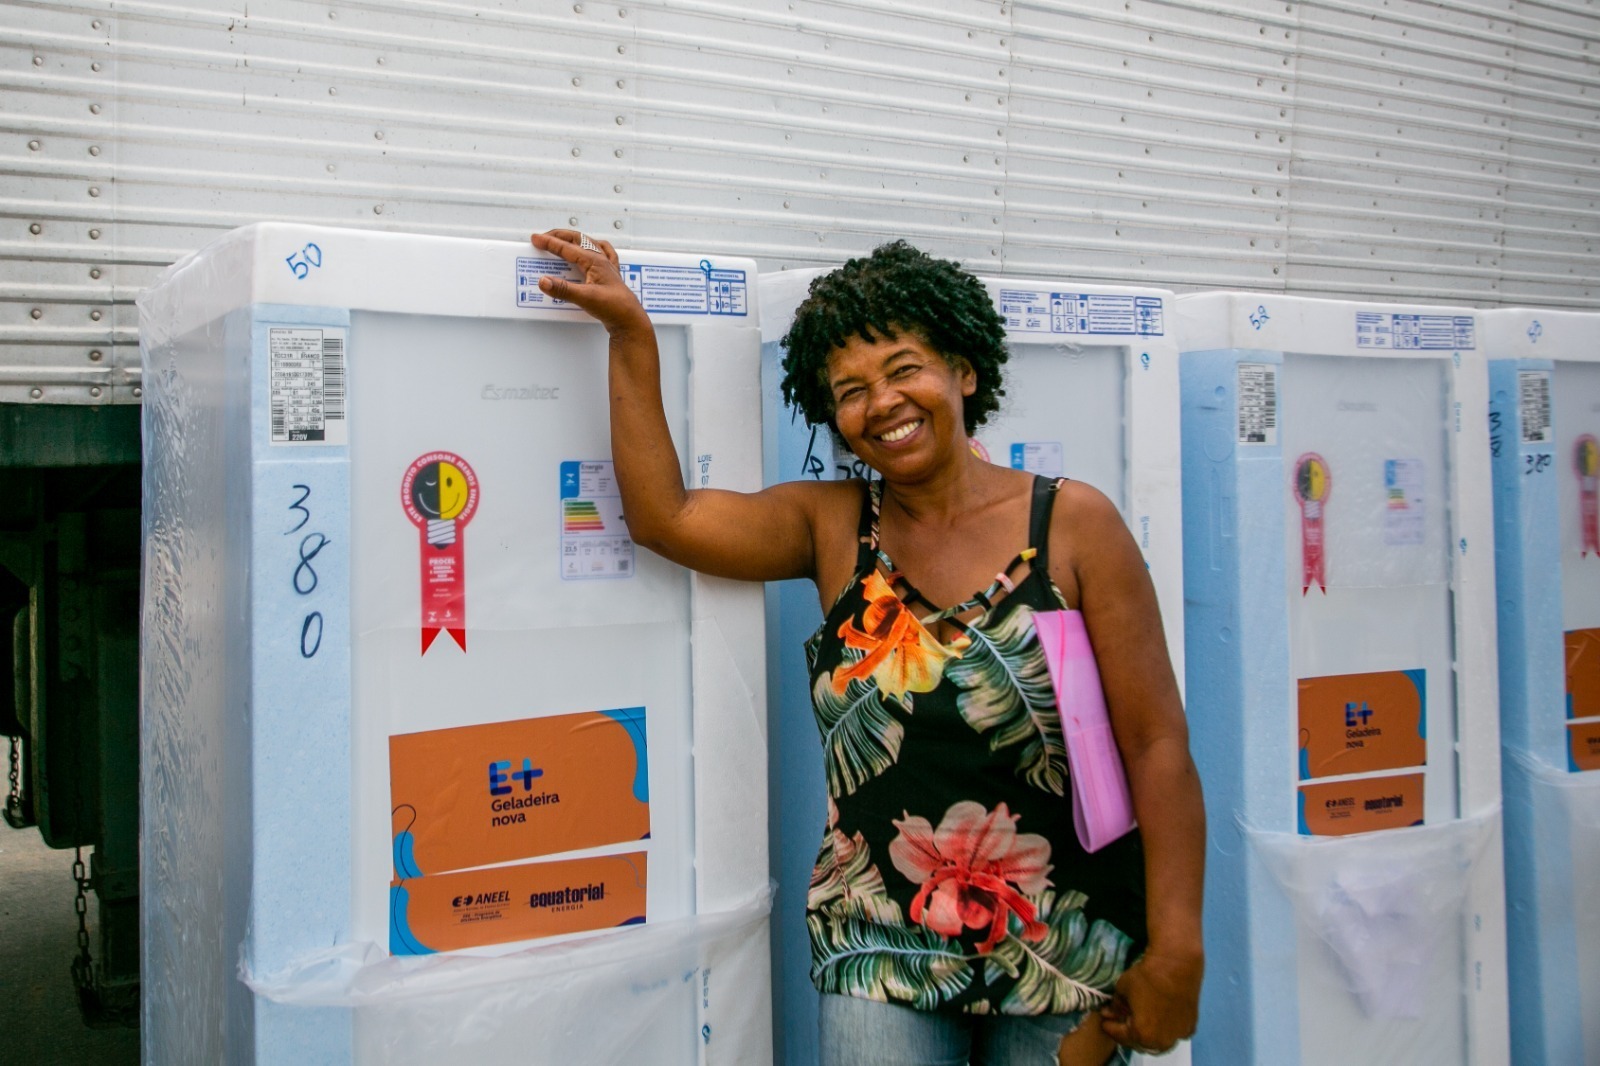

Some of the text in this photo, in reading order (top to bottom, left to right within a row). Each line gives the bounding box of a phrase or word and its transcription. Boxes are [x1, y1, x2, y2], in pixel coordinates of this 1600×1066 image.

[286, 243, 322, 280] 50
[481, 384, 559, 400] Esmaltec
[291, 433, 308, 441] 220V
[416, 454, 457, 467] CONSOME
[581, 464, 604, 472] Energia
[456, 460, 476, 487] MENOS
[403, 466, 417, 506] PRODUTO
[458, 488, 477, 521] ENERGIA
[1346, 727, 1382, 739] Geladeira
[1346, 740, 1364, 749] nova
[489, 757, 543, 796] E+
[491, 792, 560, 813] Geladeira
[491, 811, 526, 827] nova
[474, 890, 511, 905] ANEEL
[529, 882, 605, 909] equatorial
[551, 904, 584, 913] ENERGIA
